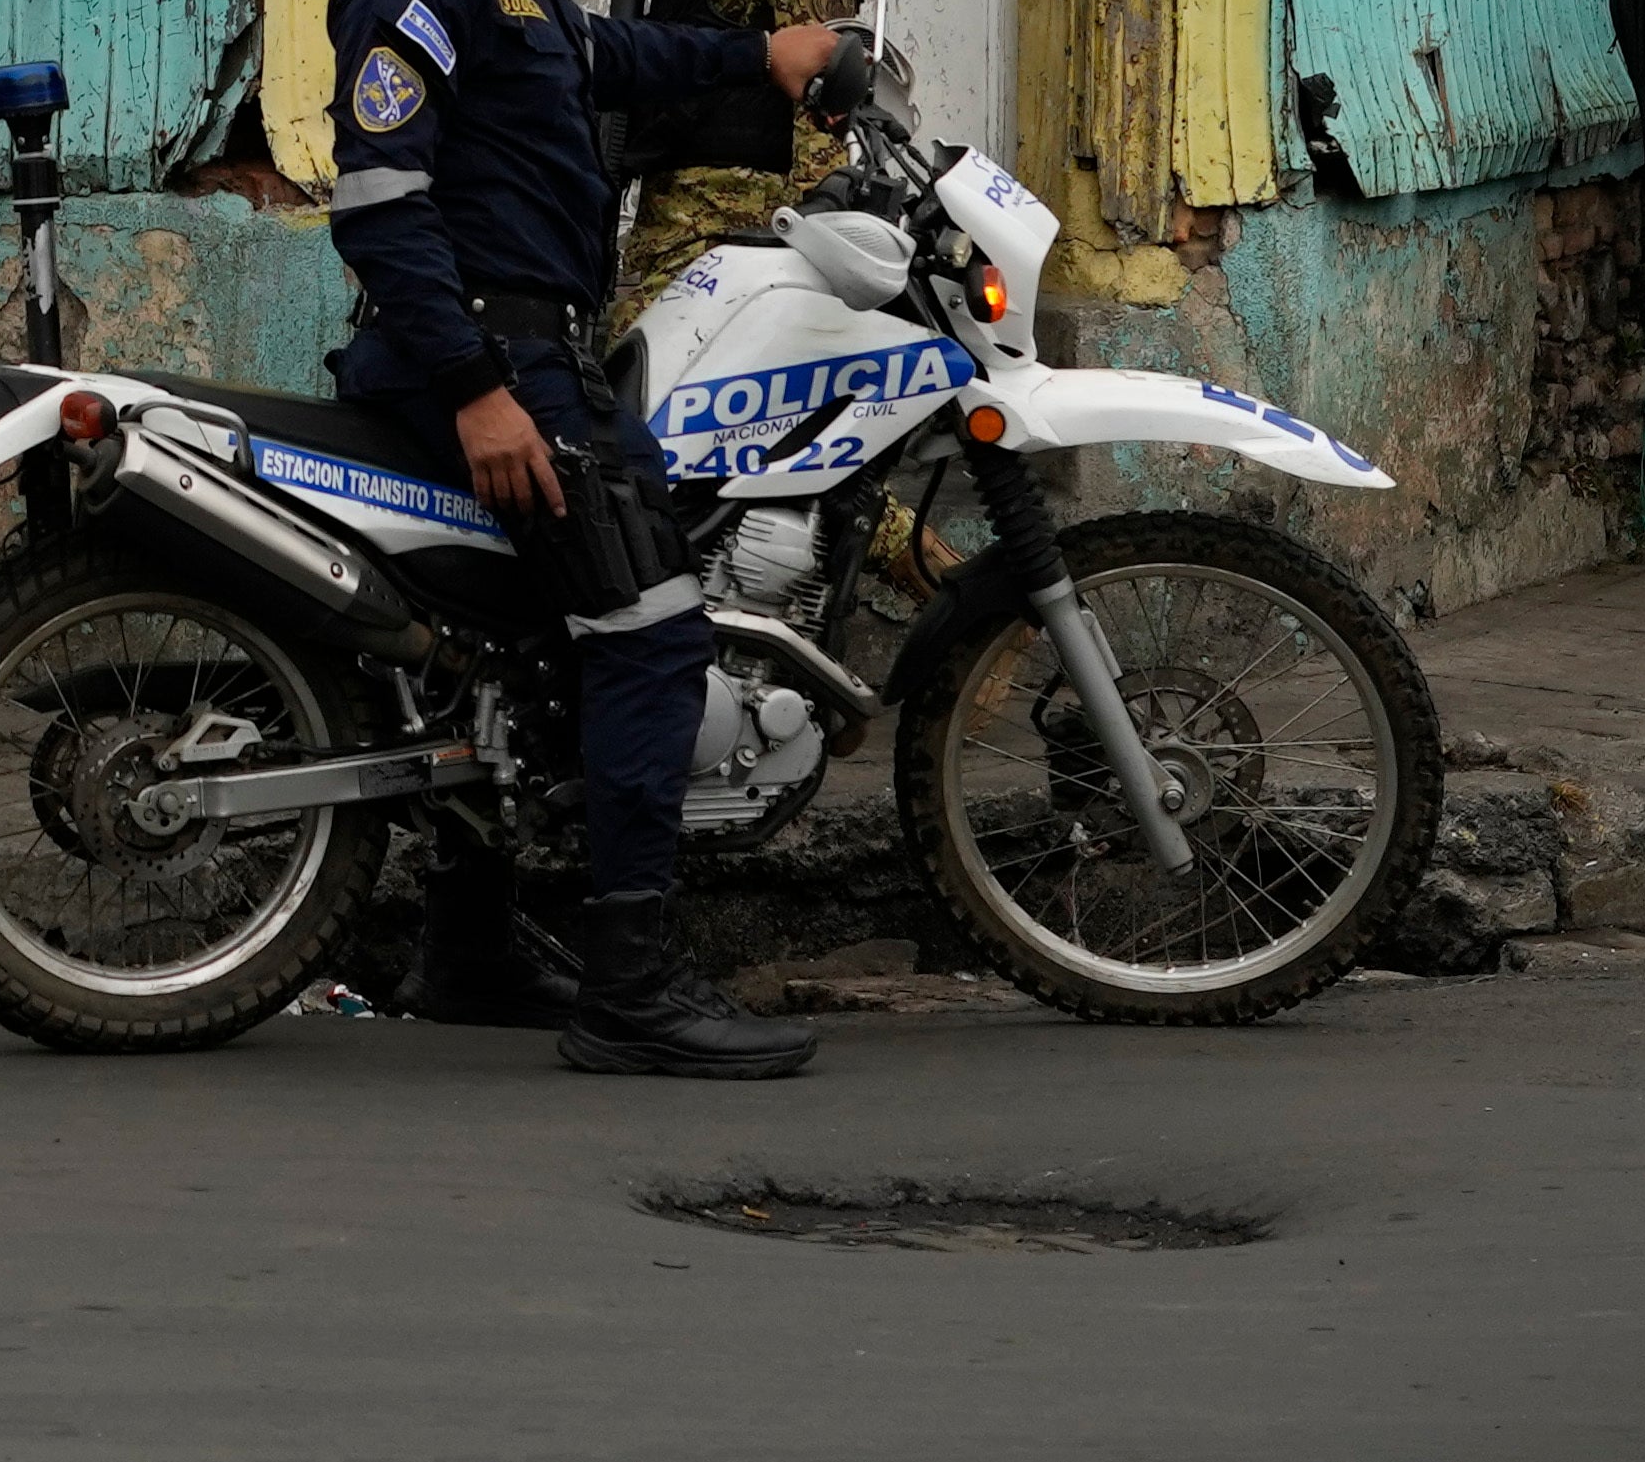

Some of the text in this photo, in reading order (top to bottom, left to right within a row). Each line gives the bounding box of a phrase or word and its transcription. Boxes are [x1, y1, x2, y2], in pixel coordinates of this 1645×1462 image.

[667, 346, 952, 436] POLICIA
[853, 402, 897, 420] CIVIL
[262, 448, 344, 491] ESTACION
[348, 468, 429, 512] TRANSITO
[433, 490, 501, 529] TERRES
